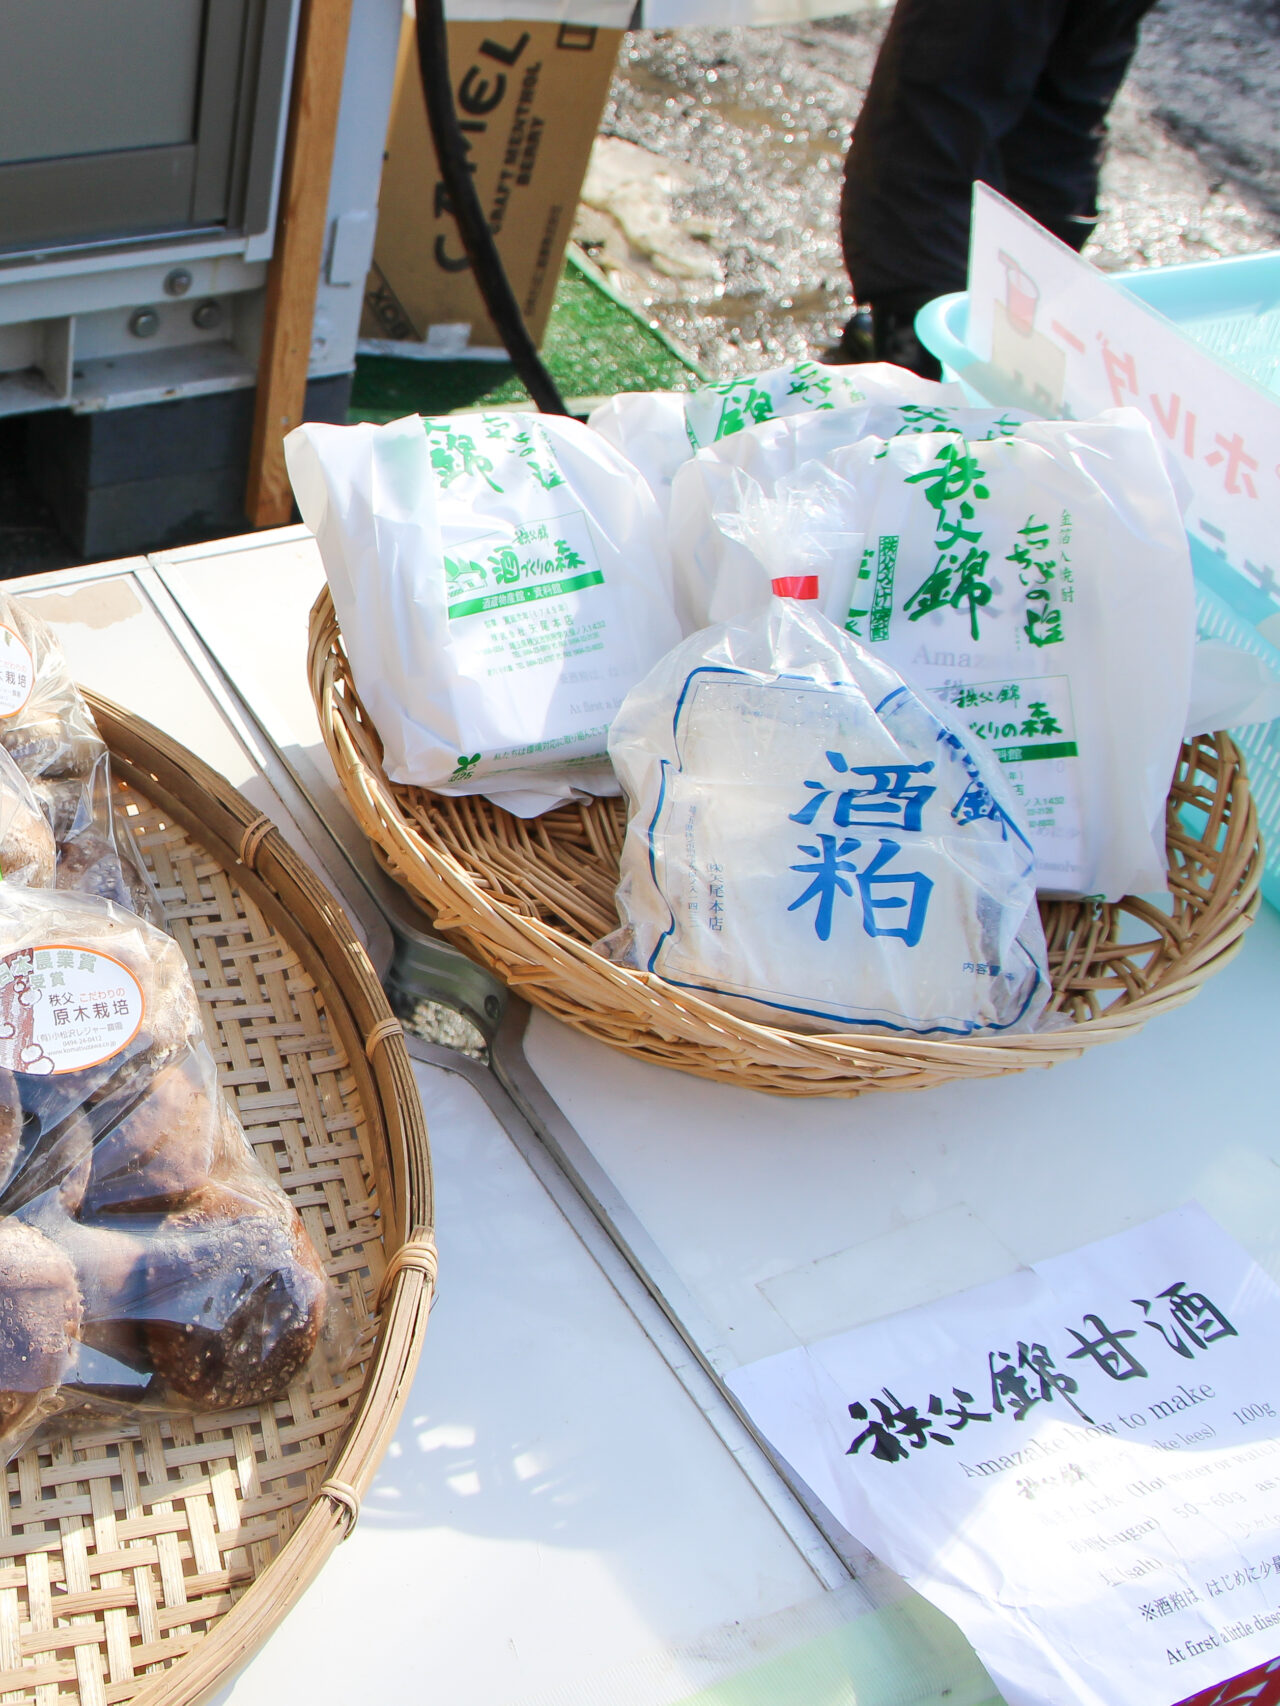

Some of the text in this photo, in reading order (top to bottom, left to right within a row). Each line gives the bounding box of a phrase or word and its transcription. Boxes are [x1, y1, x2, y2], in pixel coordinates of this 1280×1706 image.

[487, 540, 586, 585] 酒づくりの森
[904, 443, 992, 641] 秩父錦
[952, 685, 1021, 708] 秩父錦
[787, 751, 935, 947] 酒粕
[30, 971, 66, 990] 受賞
[49, 987, 125, 1006] 秩父 こだわりの
[53, 999, 130, 1026] 原木栽培
[845, 1281, 1240, 1463] 秩父錦甘酒
[958, 1438, 1066, 1478] Amazake
[1064, 1424, 1117, 1447] how
[1119, 1411, 1147, 1430] to
[1148, 1383, 1216, 1421] make
[1233, 1402, 1276, 1425] 100g
[1167, 1648, 1186, 1665] At
[1185, 1634, 1220, 1657] first
[1223, 1621, 1255, 1641] little
